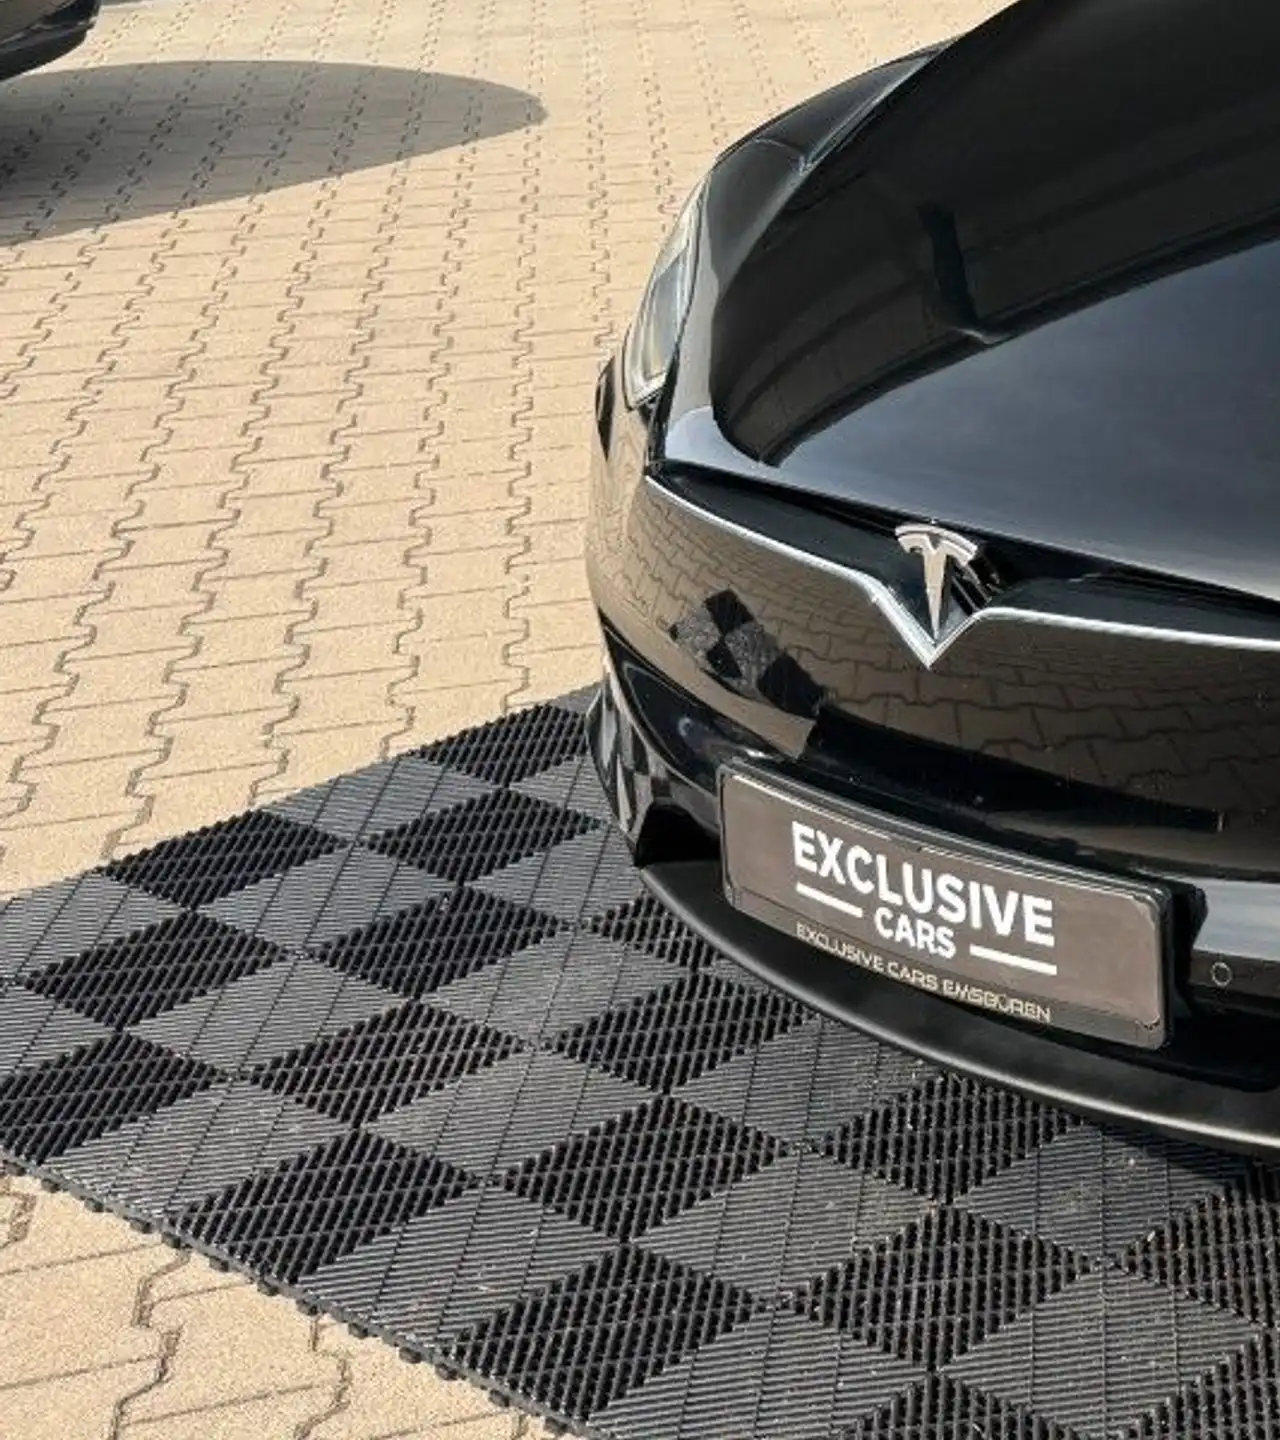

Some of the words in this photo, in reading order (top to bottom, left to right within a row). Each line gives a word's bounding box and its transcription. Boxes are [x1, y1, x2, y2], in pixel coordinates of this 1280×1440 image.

[791, 820, 1056, 947] EXCLUSIVE
[796, 921, 885, 973] EXCLUSIVE
[873, 907, 957, 959] CARS
[887, 961, 938, 990] CARS
